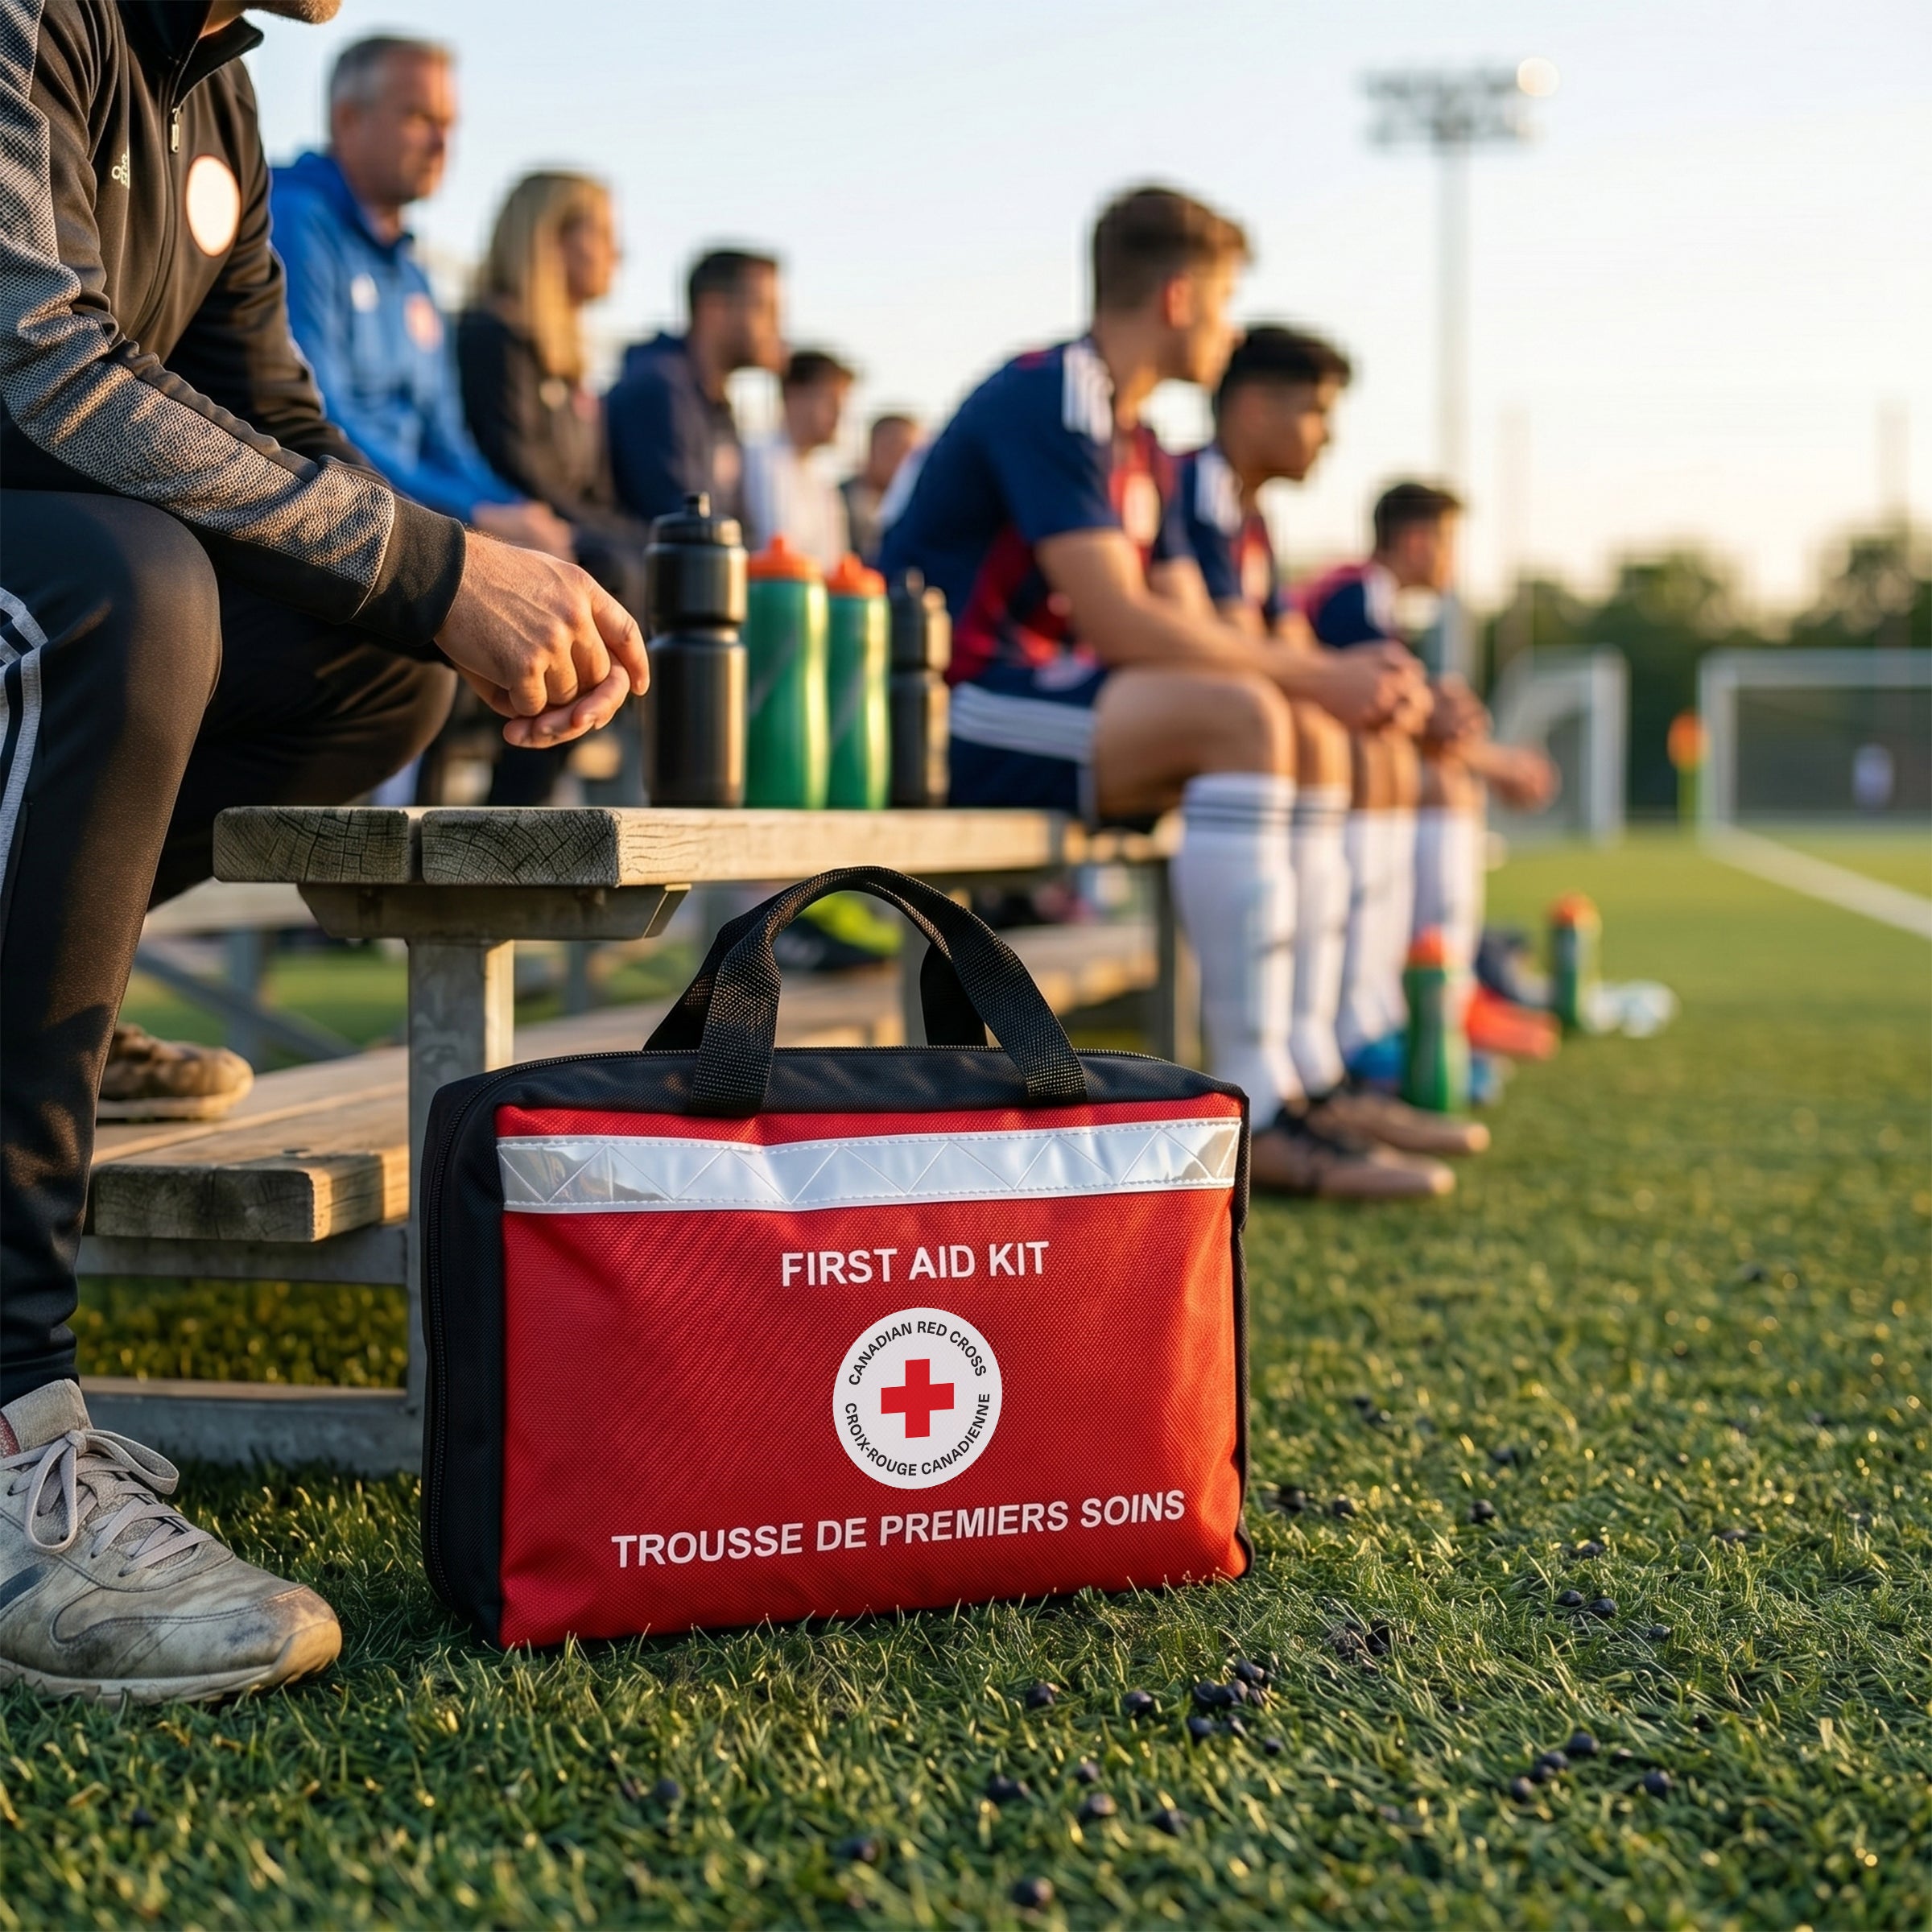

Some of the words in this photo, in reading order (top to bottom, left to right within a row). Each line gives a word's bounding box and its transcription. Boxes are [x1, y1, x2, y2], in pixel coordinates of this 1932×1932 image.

[782, 1248, 898, 1287] FIRST
[909, 1245, 976, 1280] AID
[989, 1241, 1050, 1277] KIT
[848, 1322, 912, 1385] CANADIAN
[917, 1320, 947, 1336] RED
[949, 1331, 987, 1377] CROSS
[845, 1402, 917, 1476] CROIX-ROUGE
[921, 1393, 990, 1475] CANADIENNE
[611, 1522, 803, 1568] TROUSSE
[816, 1517, 867, 1551] DE
[880, 1501, 1068, 1546] PREMIERS
[1080, 1489, 1185, 1528] SOINS
